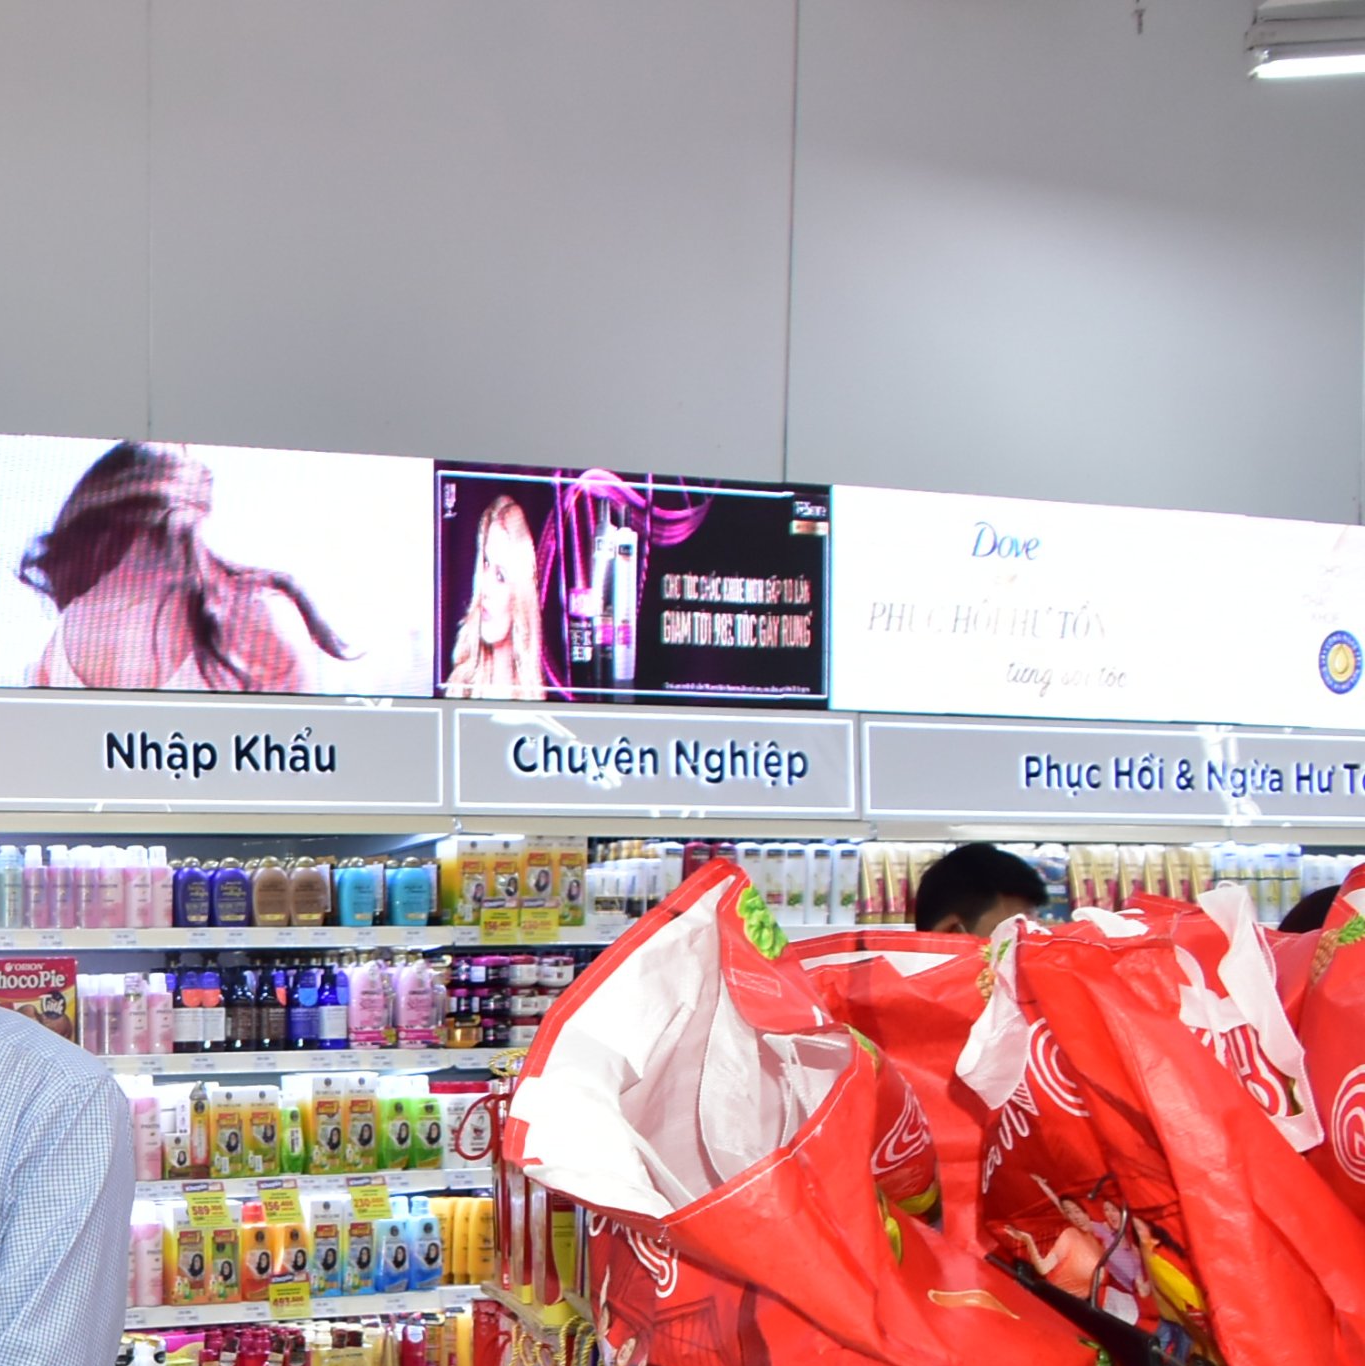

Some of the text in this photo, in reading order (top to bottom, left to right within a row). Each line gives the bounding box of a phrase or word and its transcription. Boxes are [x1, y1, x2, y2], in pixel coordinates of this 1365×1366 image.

[971, 521, 1041, 560] Dove
[105, 726, 337, 786] Nhập Khẩu
[510, 734, 810, 787] Chuyên Nghiệp
[1023, 753, 1365, 799] Phục Hồi & Ngừa Hư T
